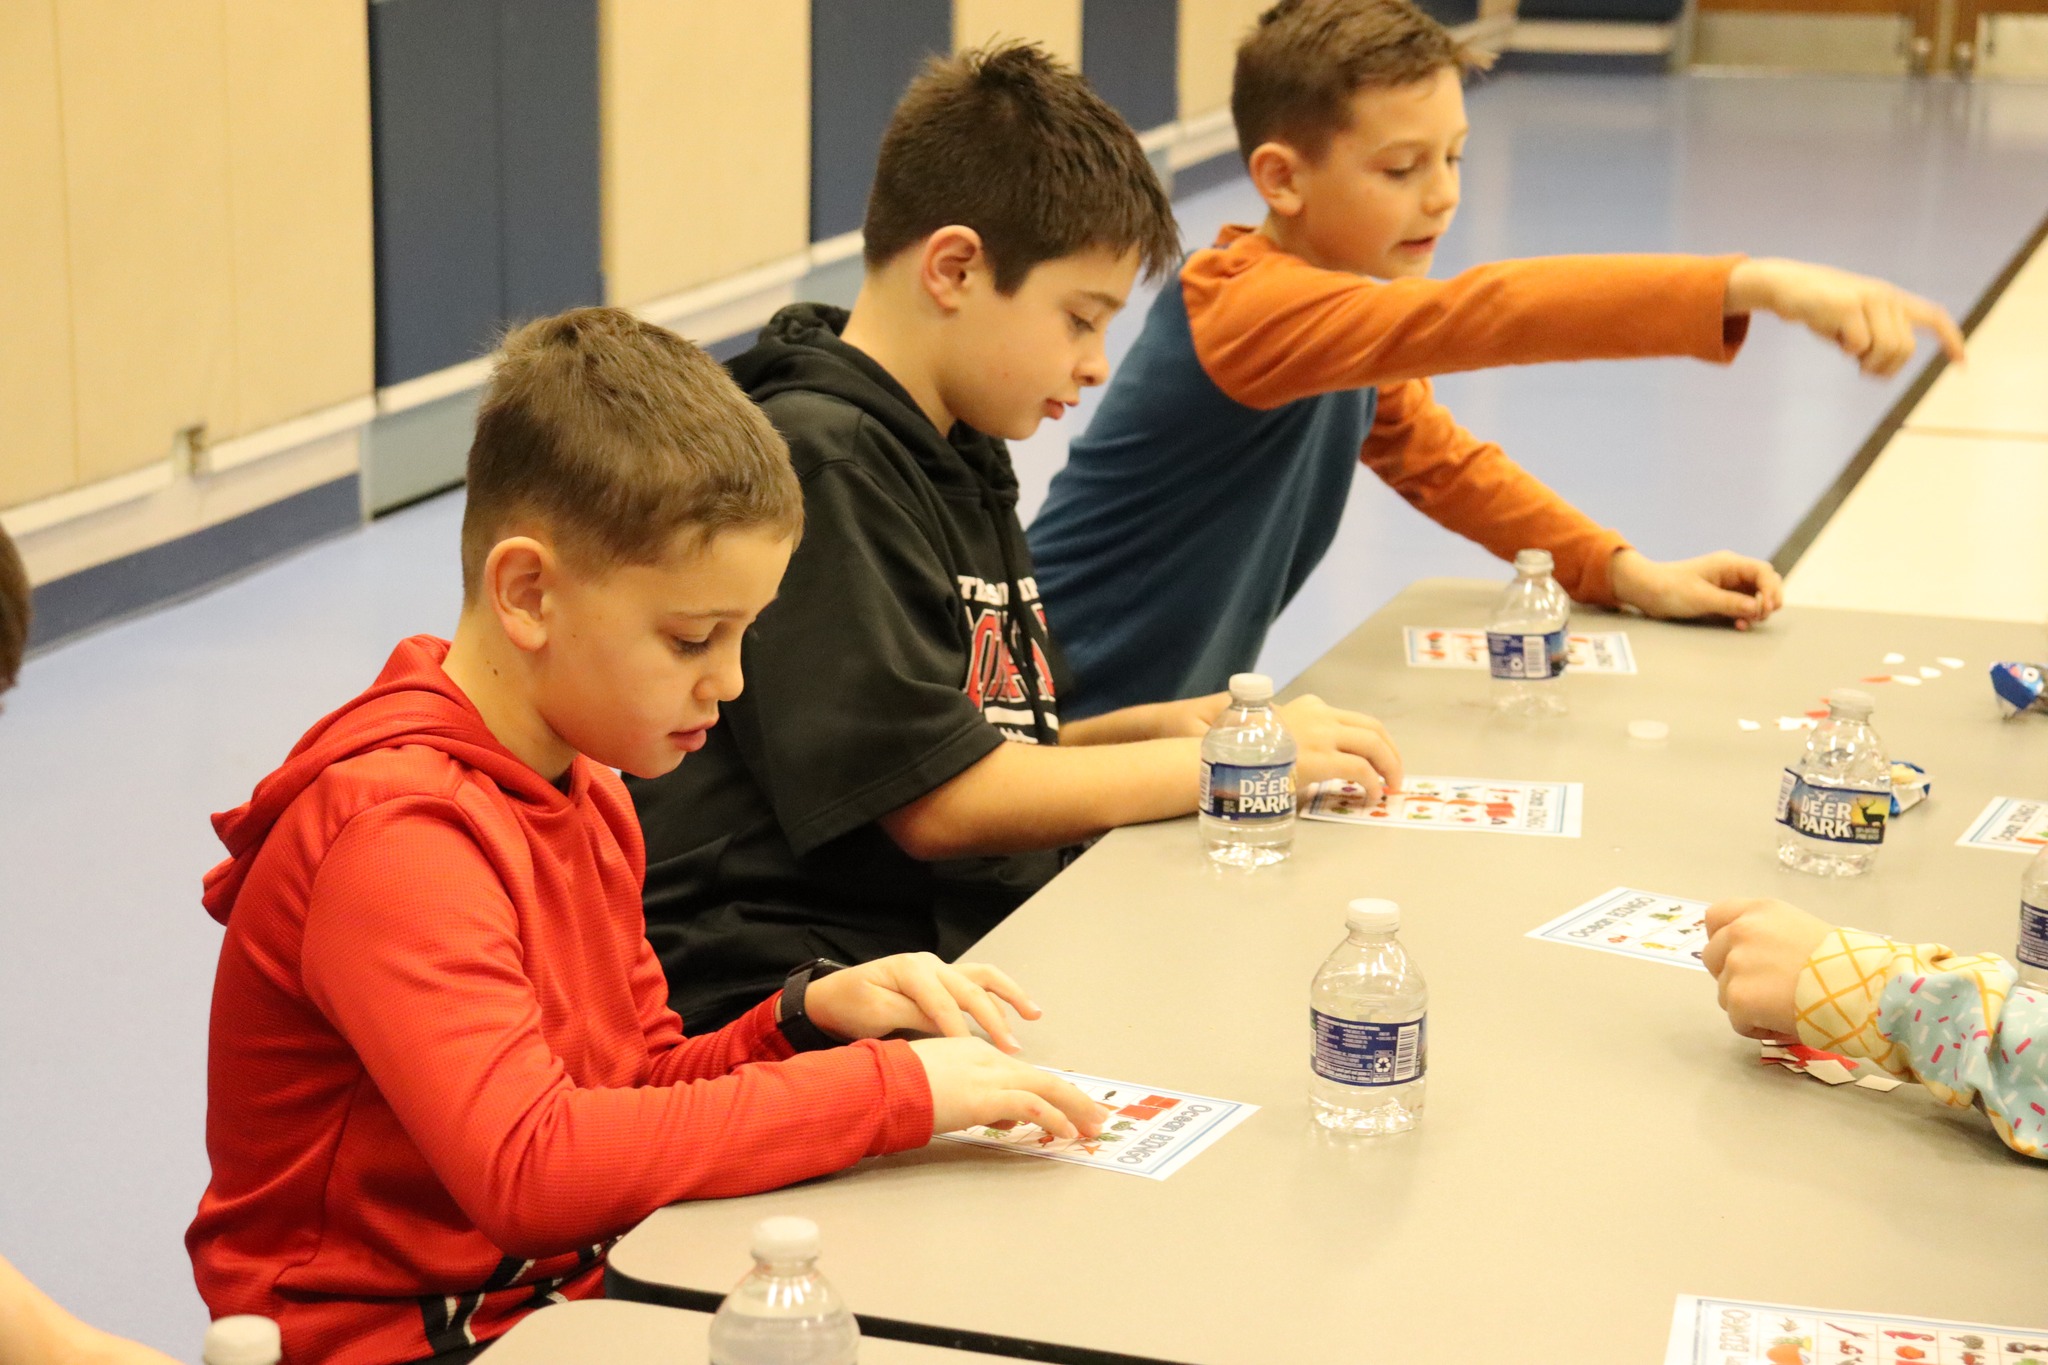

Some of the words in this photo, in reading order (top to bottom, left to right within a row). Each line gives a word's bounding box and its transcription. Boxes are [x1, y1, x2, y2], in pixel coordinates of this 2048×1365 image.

[1240, 776, 1290, 796] DEER
[1238, 793, 1290, 813] PARK
[1801, 795, 1852, 820] DEER
[1800, 813, 1852, 839] PARK
[1157, 1104, 1213, 1133] Ocean
[1117, 1133, 1175, 1165] BINGO
